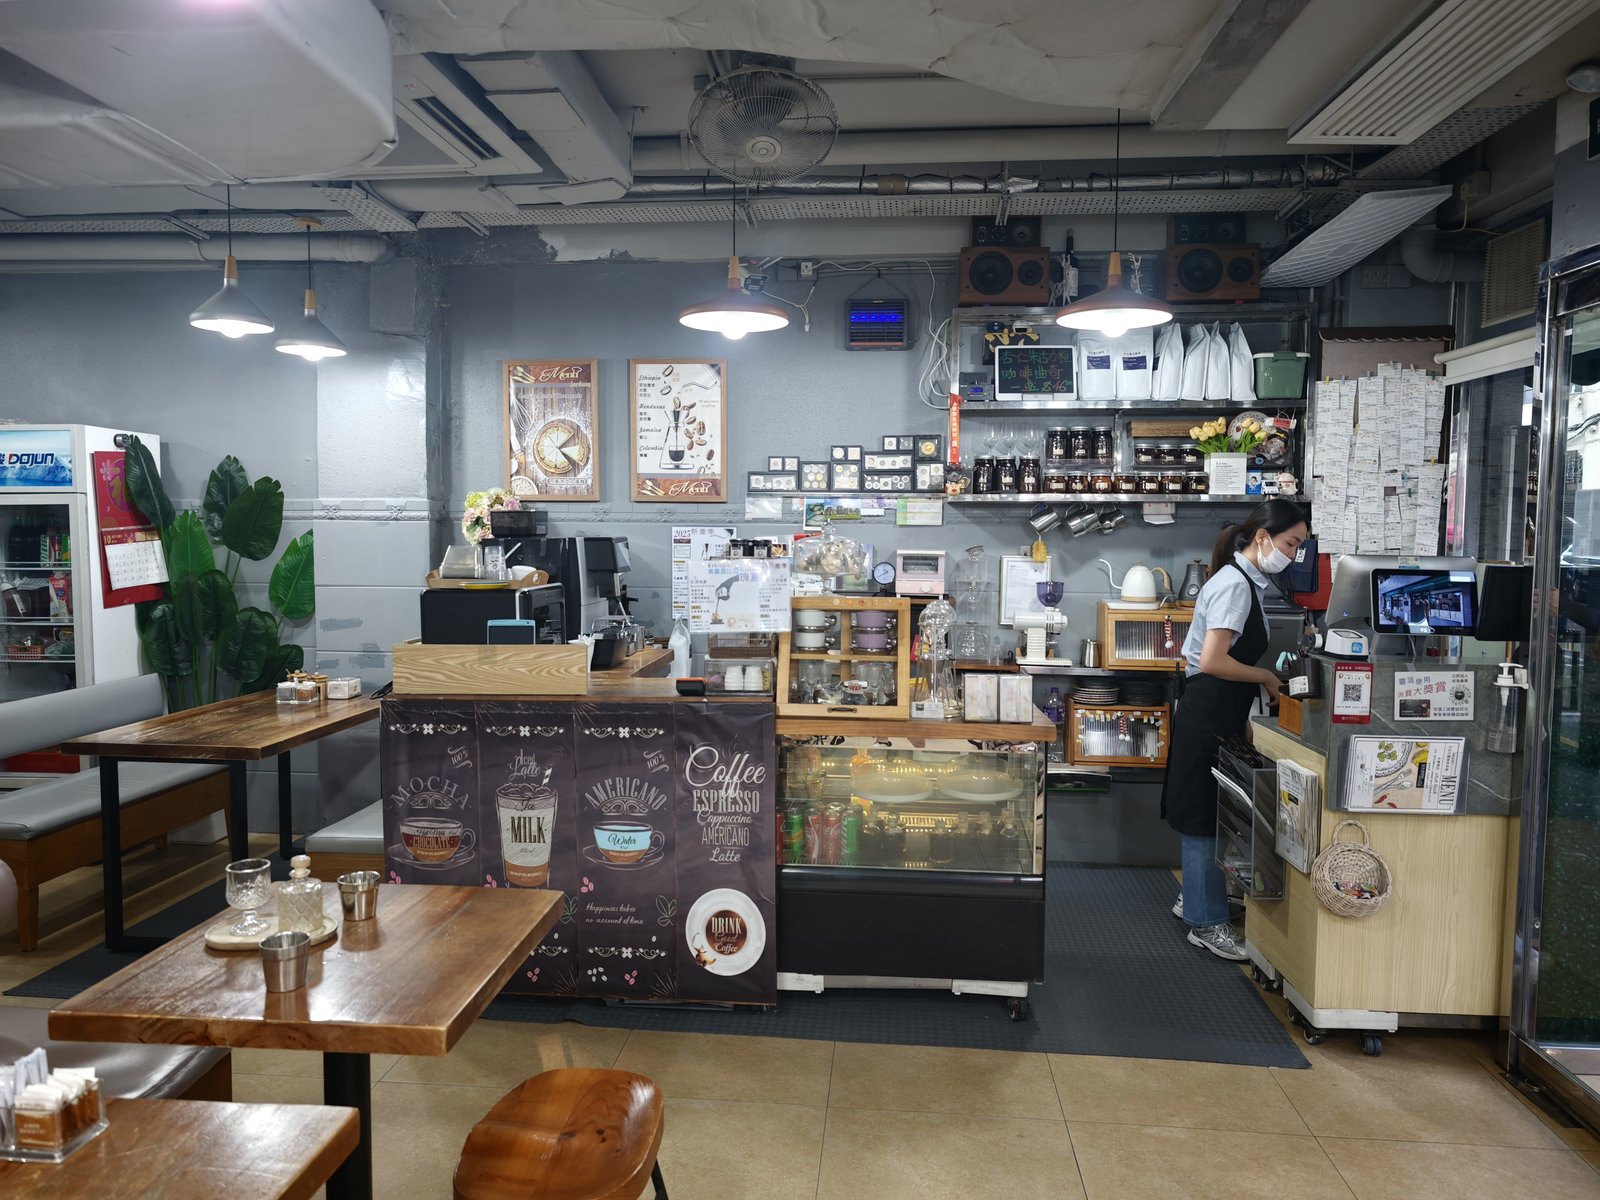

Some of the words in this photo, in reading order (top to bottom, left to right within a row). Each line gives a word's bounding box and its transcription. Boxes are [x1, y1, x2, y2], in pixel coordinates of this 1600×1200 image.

[539, 366, 582, 382] Menu
[1002, 364, 1063, 380] 咖啡曲奇
[8, 453, 55, 467] DOJUN
[669, 480, 713, 496] Menu
[451, 749, 469, 765] 100%
[647, 753, 665, 769] 100%
[509, 756, 541, 780] Latte
[686, 746, 766, 799] Coffee
[585, 776, 667, 811] AMERICANO
[1438, 774, 1458, 806] MENU
[692, 789, 760, 814] ESPRESSO
[697, 807, 752, 827] Cappuccino
[510, 816, 546, 844] MILK
[701, 826, 750, 846] AMERICANO
[413, 834, 451, 850] CHOCOLATE
[607, 832, 637, 846] Water
[708, 847, 741, 862] Latte
[586, 902, 618, 914] Happiness
[619, 903, 637, 913] takes
[711, 916, 742, 934] DRINK
[714, 943, 739, 955] Coffee
